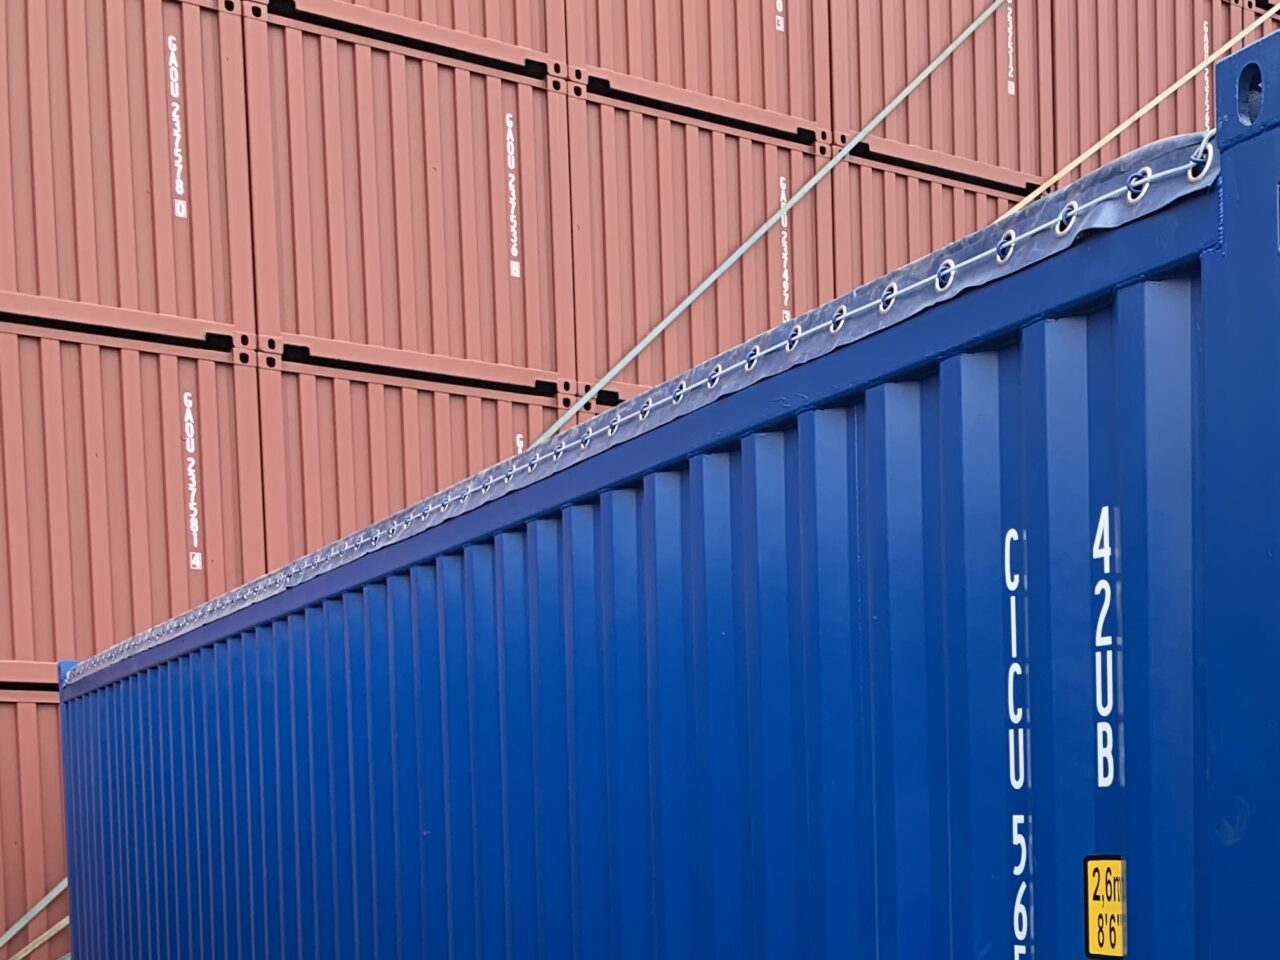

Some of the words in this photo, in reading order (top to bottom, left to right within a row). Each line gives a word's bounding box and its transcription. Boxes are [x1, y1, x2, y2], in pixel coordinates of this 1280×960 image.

[168, 35, 179, 98] GAOU
[170, 102, 184, 194] 237578
[506, 113, 516, 169] GAOU
[508, 173, 518, 257] 237536
[183, 392, 195, 453] GAOU
[186, 457, 199, 548] 237581
[1004, 528, 1031, 790] CICU
[1092, 505, 1124, 788] 42UB
